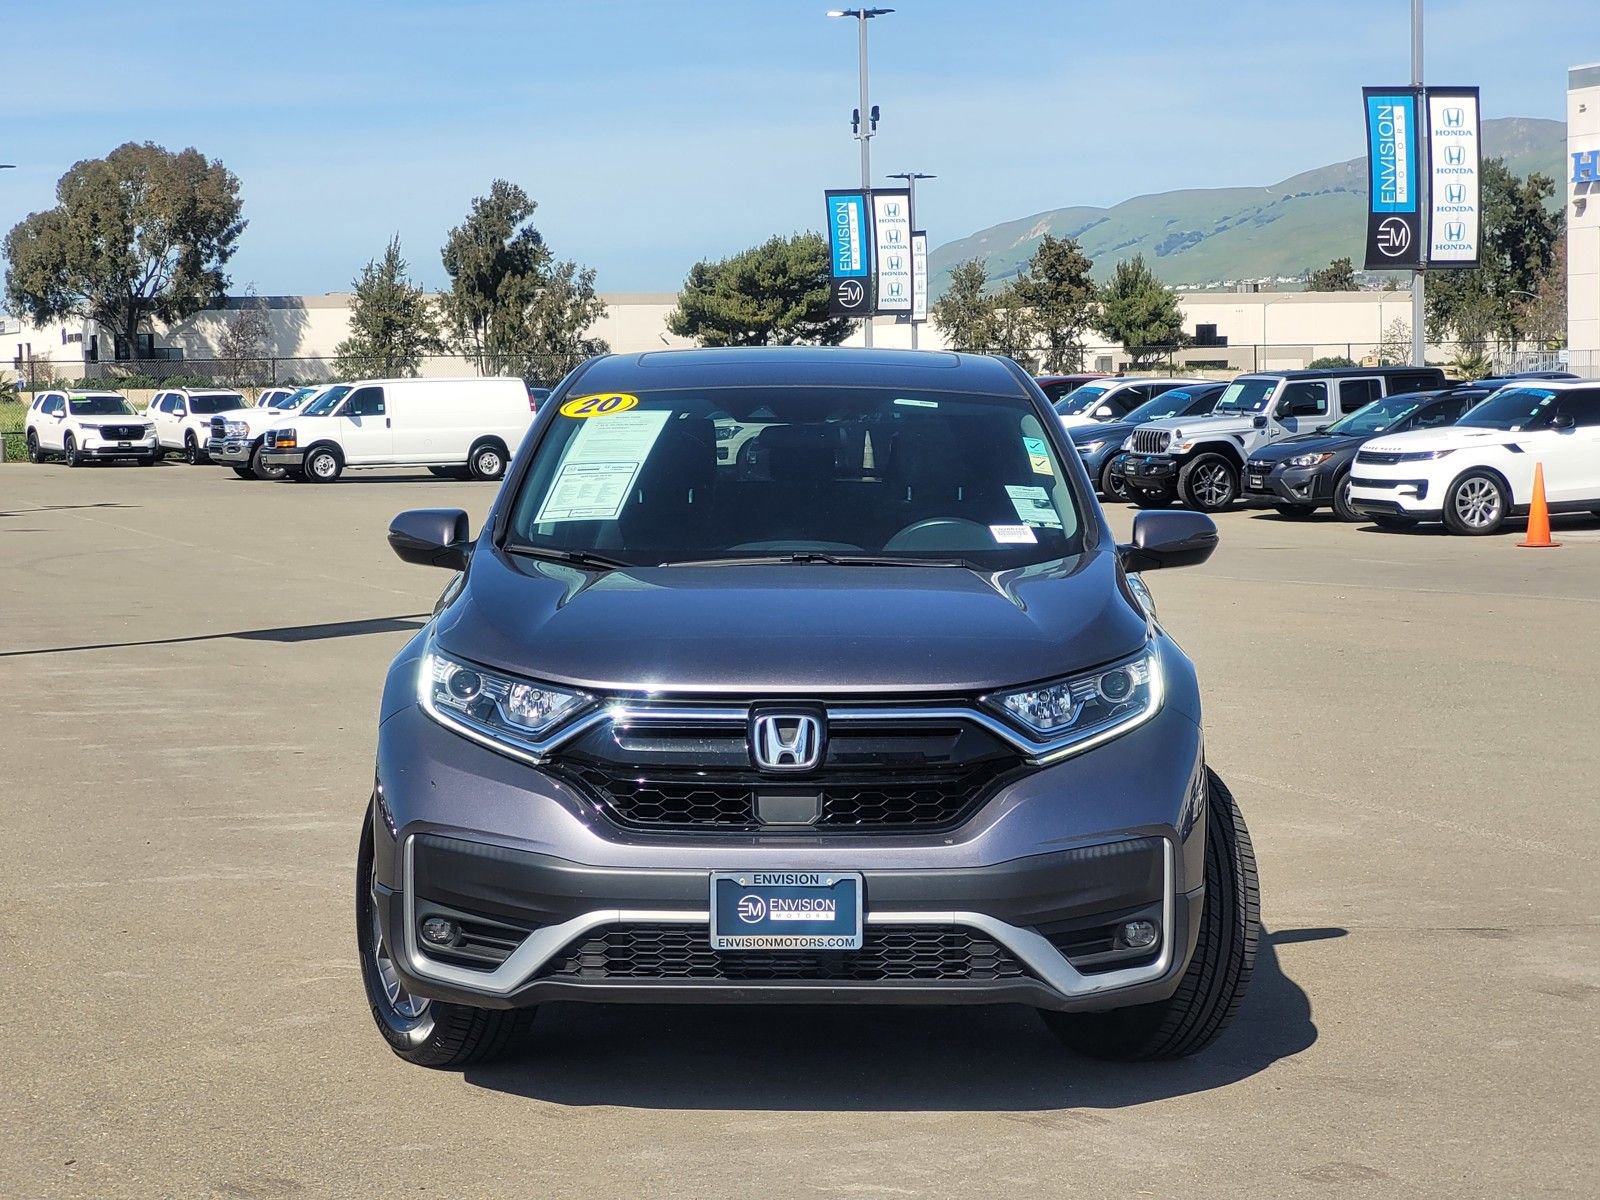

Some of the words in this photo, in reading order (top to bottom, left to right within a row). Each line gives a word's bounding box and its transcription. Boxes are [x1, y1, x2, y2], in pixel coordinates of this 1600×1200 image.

[1377, 104, 1396, 204] ENVISION
[1396, 114, 1405, 196] MOTORS
[836, 202, 852, 271] ENVISION
[574, 397, 622, 414] 20
[753, 874, 819, 885] ENVISION
[770, 898, 836, 911] ENVISION
[718, 937, 855, 948] ENVISIONMOTORS.COM
